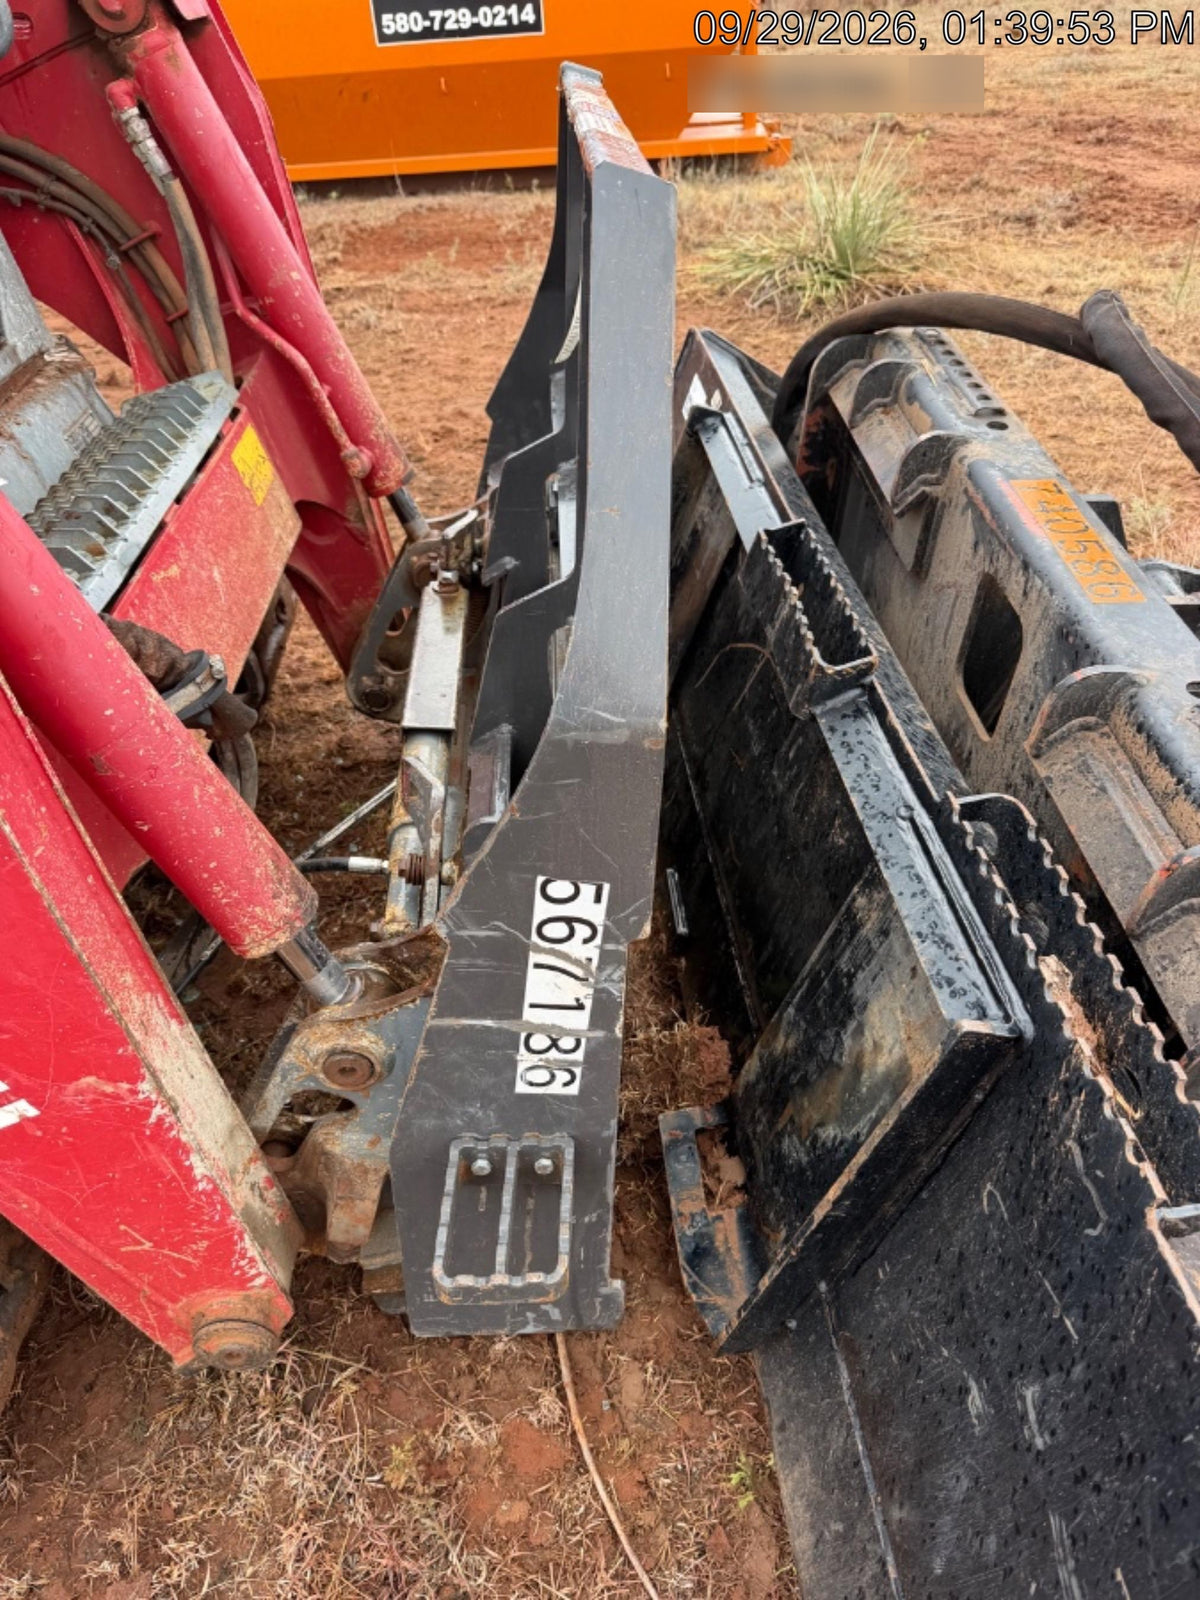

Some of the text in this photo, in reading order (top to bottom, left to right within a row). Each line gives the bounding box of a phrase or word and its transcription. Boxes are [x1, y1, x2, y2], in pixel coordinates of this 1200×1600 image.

[381, 3, 536, 34] 580-729-0214
[1017, 483, 1138, 598] 740586
[520, 878, 604, 1088] 567186
